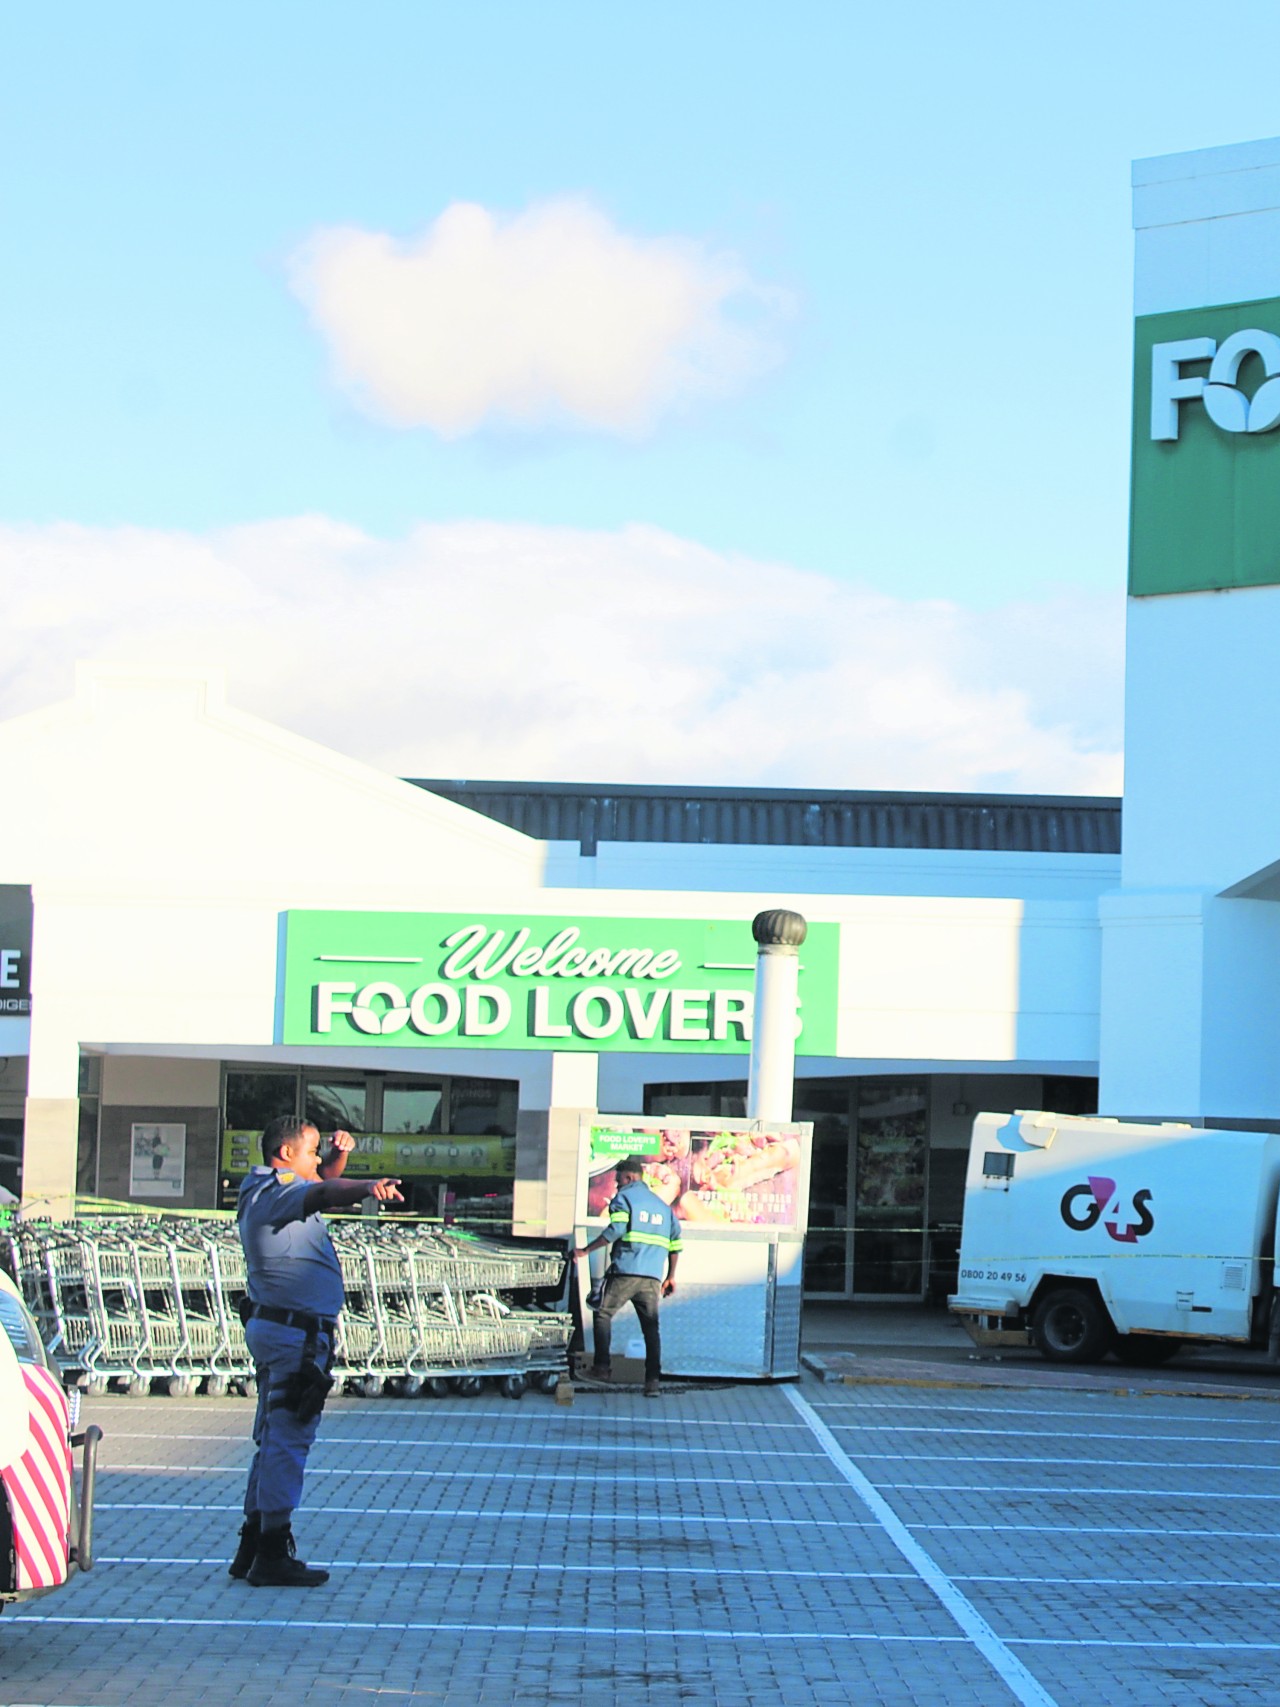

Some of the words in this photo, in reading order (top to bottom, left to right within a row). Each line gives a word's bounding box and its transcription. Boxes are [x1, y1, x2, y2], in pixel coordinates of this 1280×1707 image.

[439, 924, 683, 980] Welcome
[312, 982, 512, 1036] FOOD
[599, 1134, 621, 1143] FOOD
[610, 1143, 644, 1152] MARKET
[1060, 1176, 1155, 1244] G4S
[961, 1269, 984, 1281] 0800
[986, 1270, 999, 1281] 20
[1001, 1271, 1013, 1282] 49
[1015, 1272, 1028, 1283] 56
